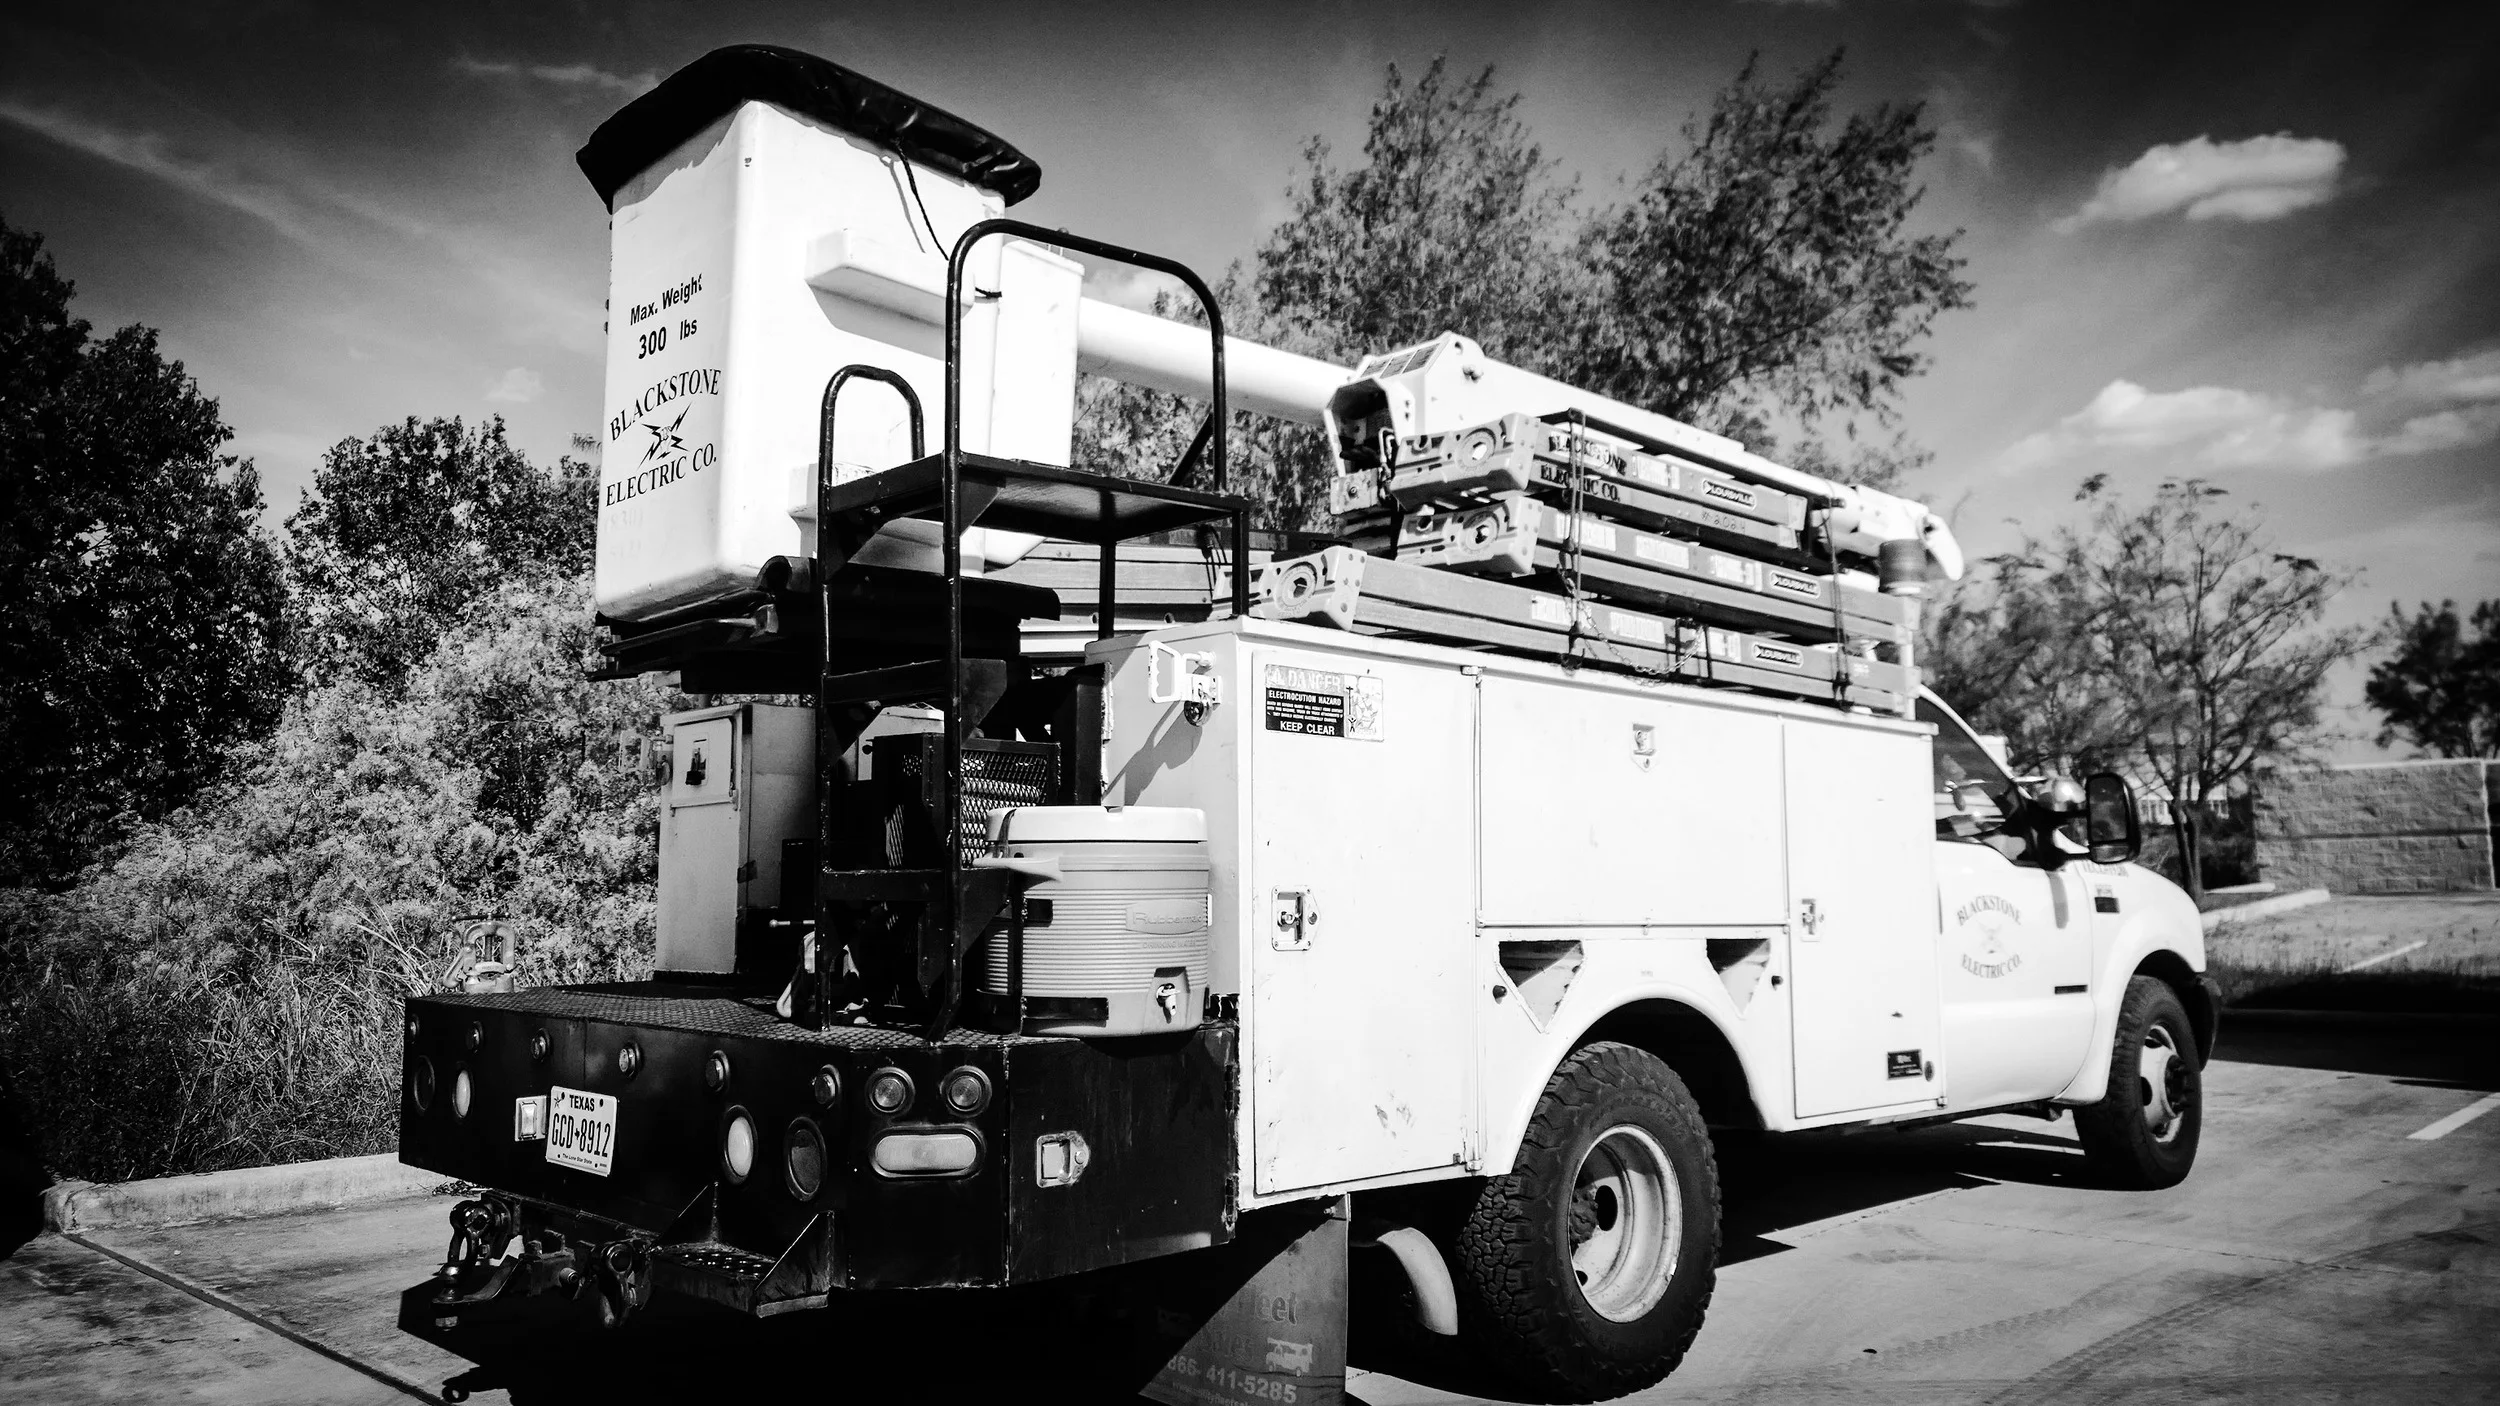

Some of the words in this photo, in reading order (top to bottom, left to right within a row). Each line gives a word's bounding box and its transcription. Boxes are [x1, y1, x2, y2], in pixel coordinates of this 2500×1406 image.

[630, 301, 658, 325] Max.
[662, 273, 703, 311] Weight
[638, 326, 667, 359] 300
[680, 318, 697, 341] lbs
[610, 368, 722, 442] BLACKSTONE
[606, 455, 686, 508] ELECTRIC
[692, 443, 717, 473] CO.
[1602, 482, 1621, 503] CO.
[1711, 484, 1755, 506] LOUISVILLE
[1777, 576, 1819, 596] LOUISVILLE
[1761, 648, 1801, 665] LOUISVILLE
[1288, 669, 1341, 693] DANGER
[1268, 690, 1317, 703] ELECTROCUTION
[1318, 696, 1342, 706] HAZARD
[1280, 720, 1303, 732] KEEP
[1306, 723, 1335, 736] CLEAR
[1957, 895, 2022, 926] BLACKSTONE
[1961, 953, 2006, 979] ELECTRIC
[569, 1094, 595, 1112] TEXAS
